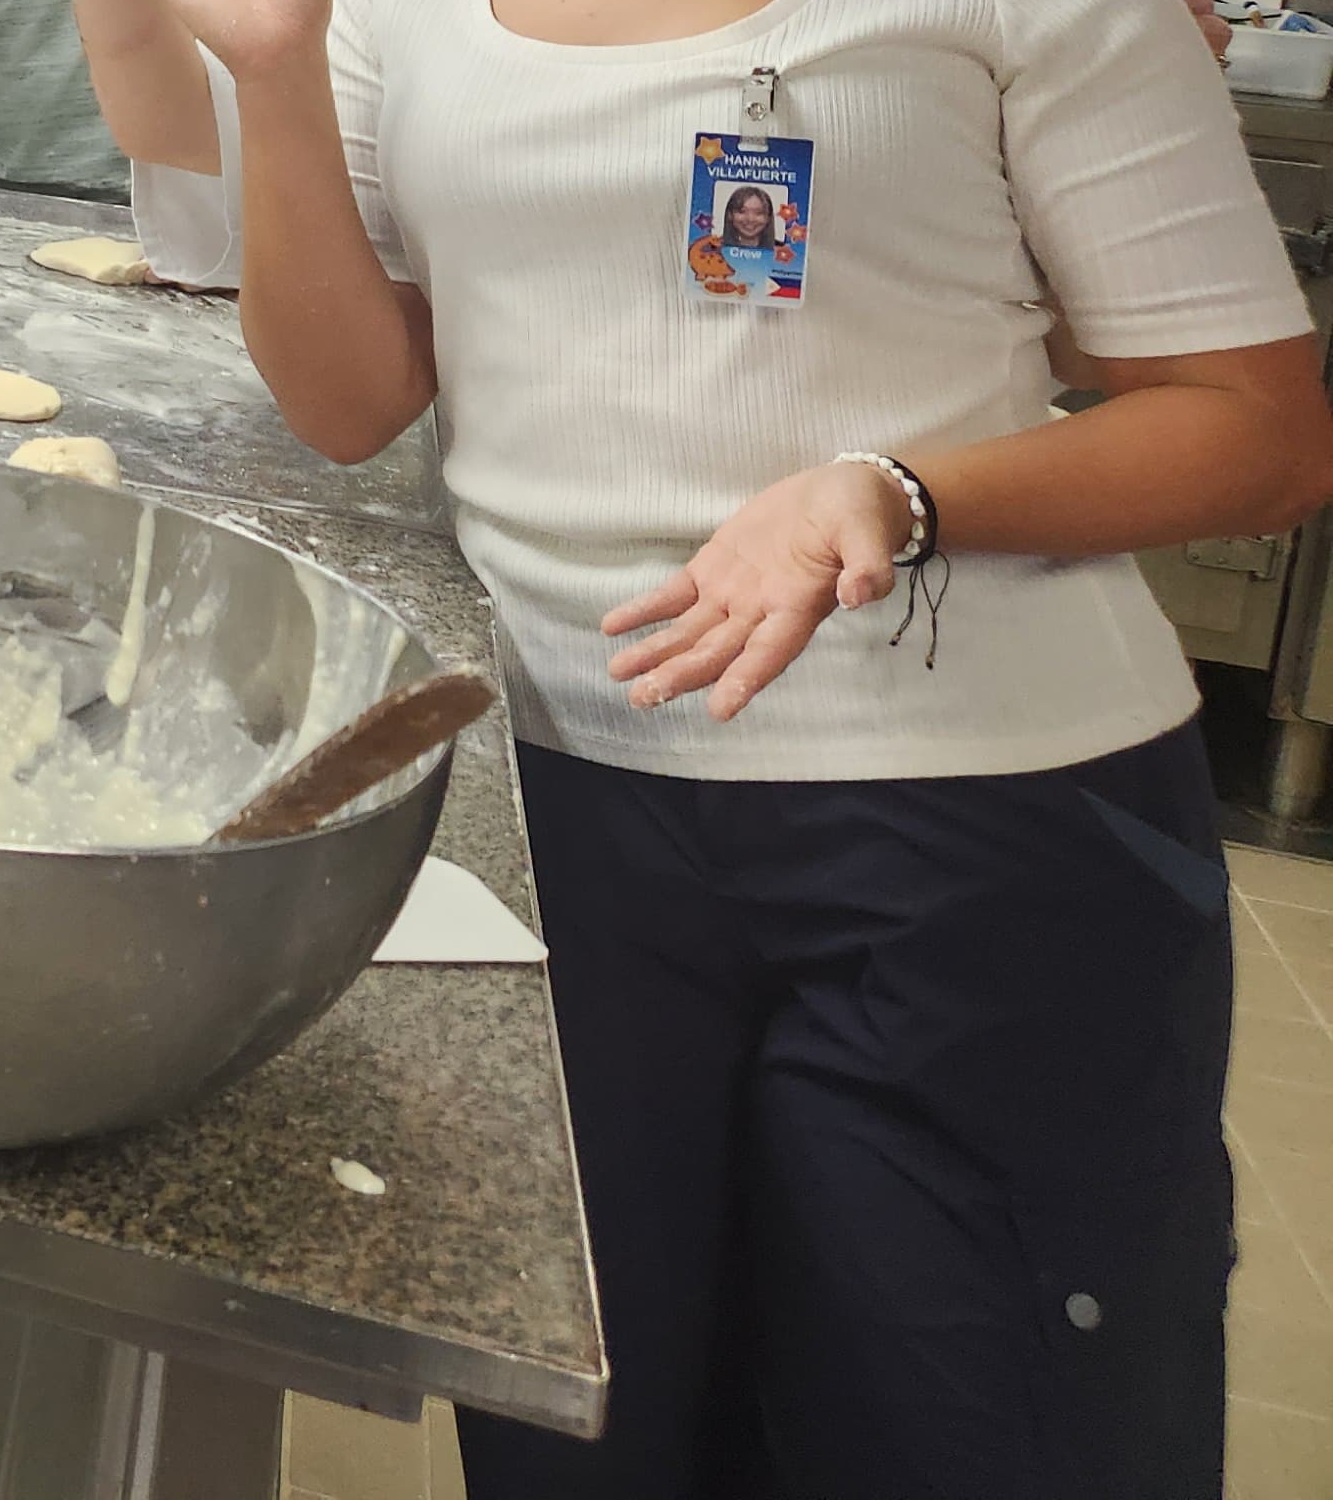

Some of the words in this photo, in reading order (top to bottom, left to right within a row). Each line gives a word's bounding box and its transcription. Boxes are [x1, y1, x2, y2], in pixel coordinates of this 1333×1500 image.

[724, 153, 780, 169] HANNAH
[707, 167, 797, 183] VILLAFUERTE
[729, 247, 762, 260] Crew
